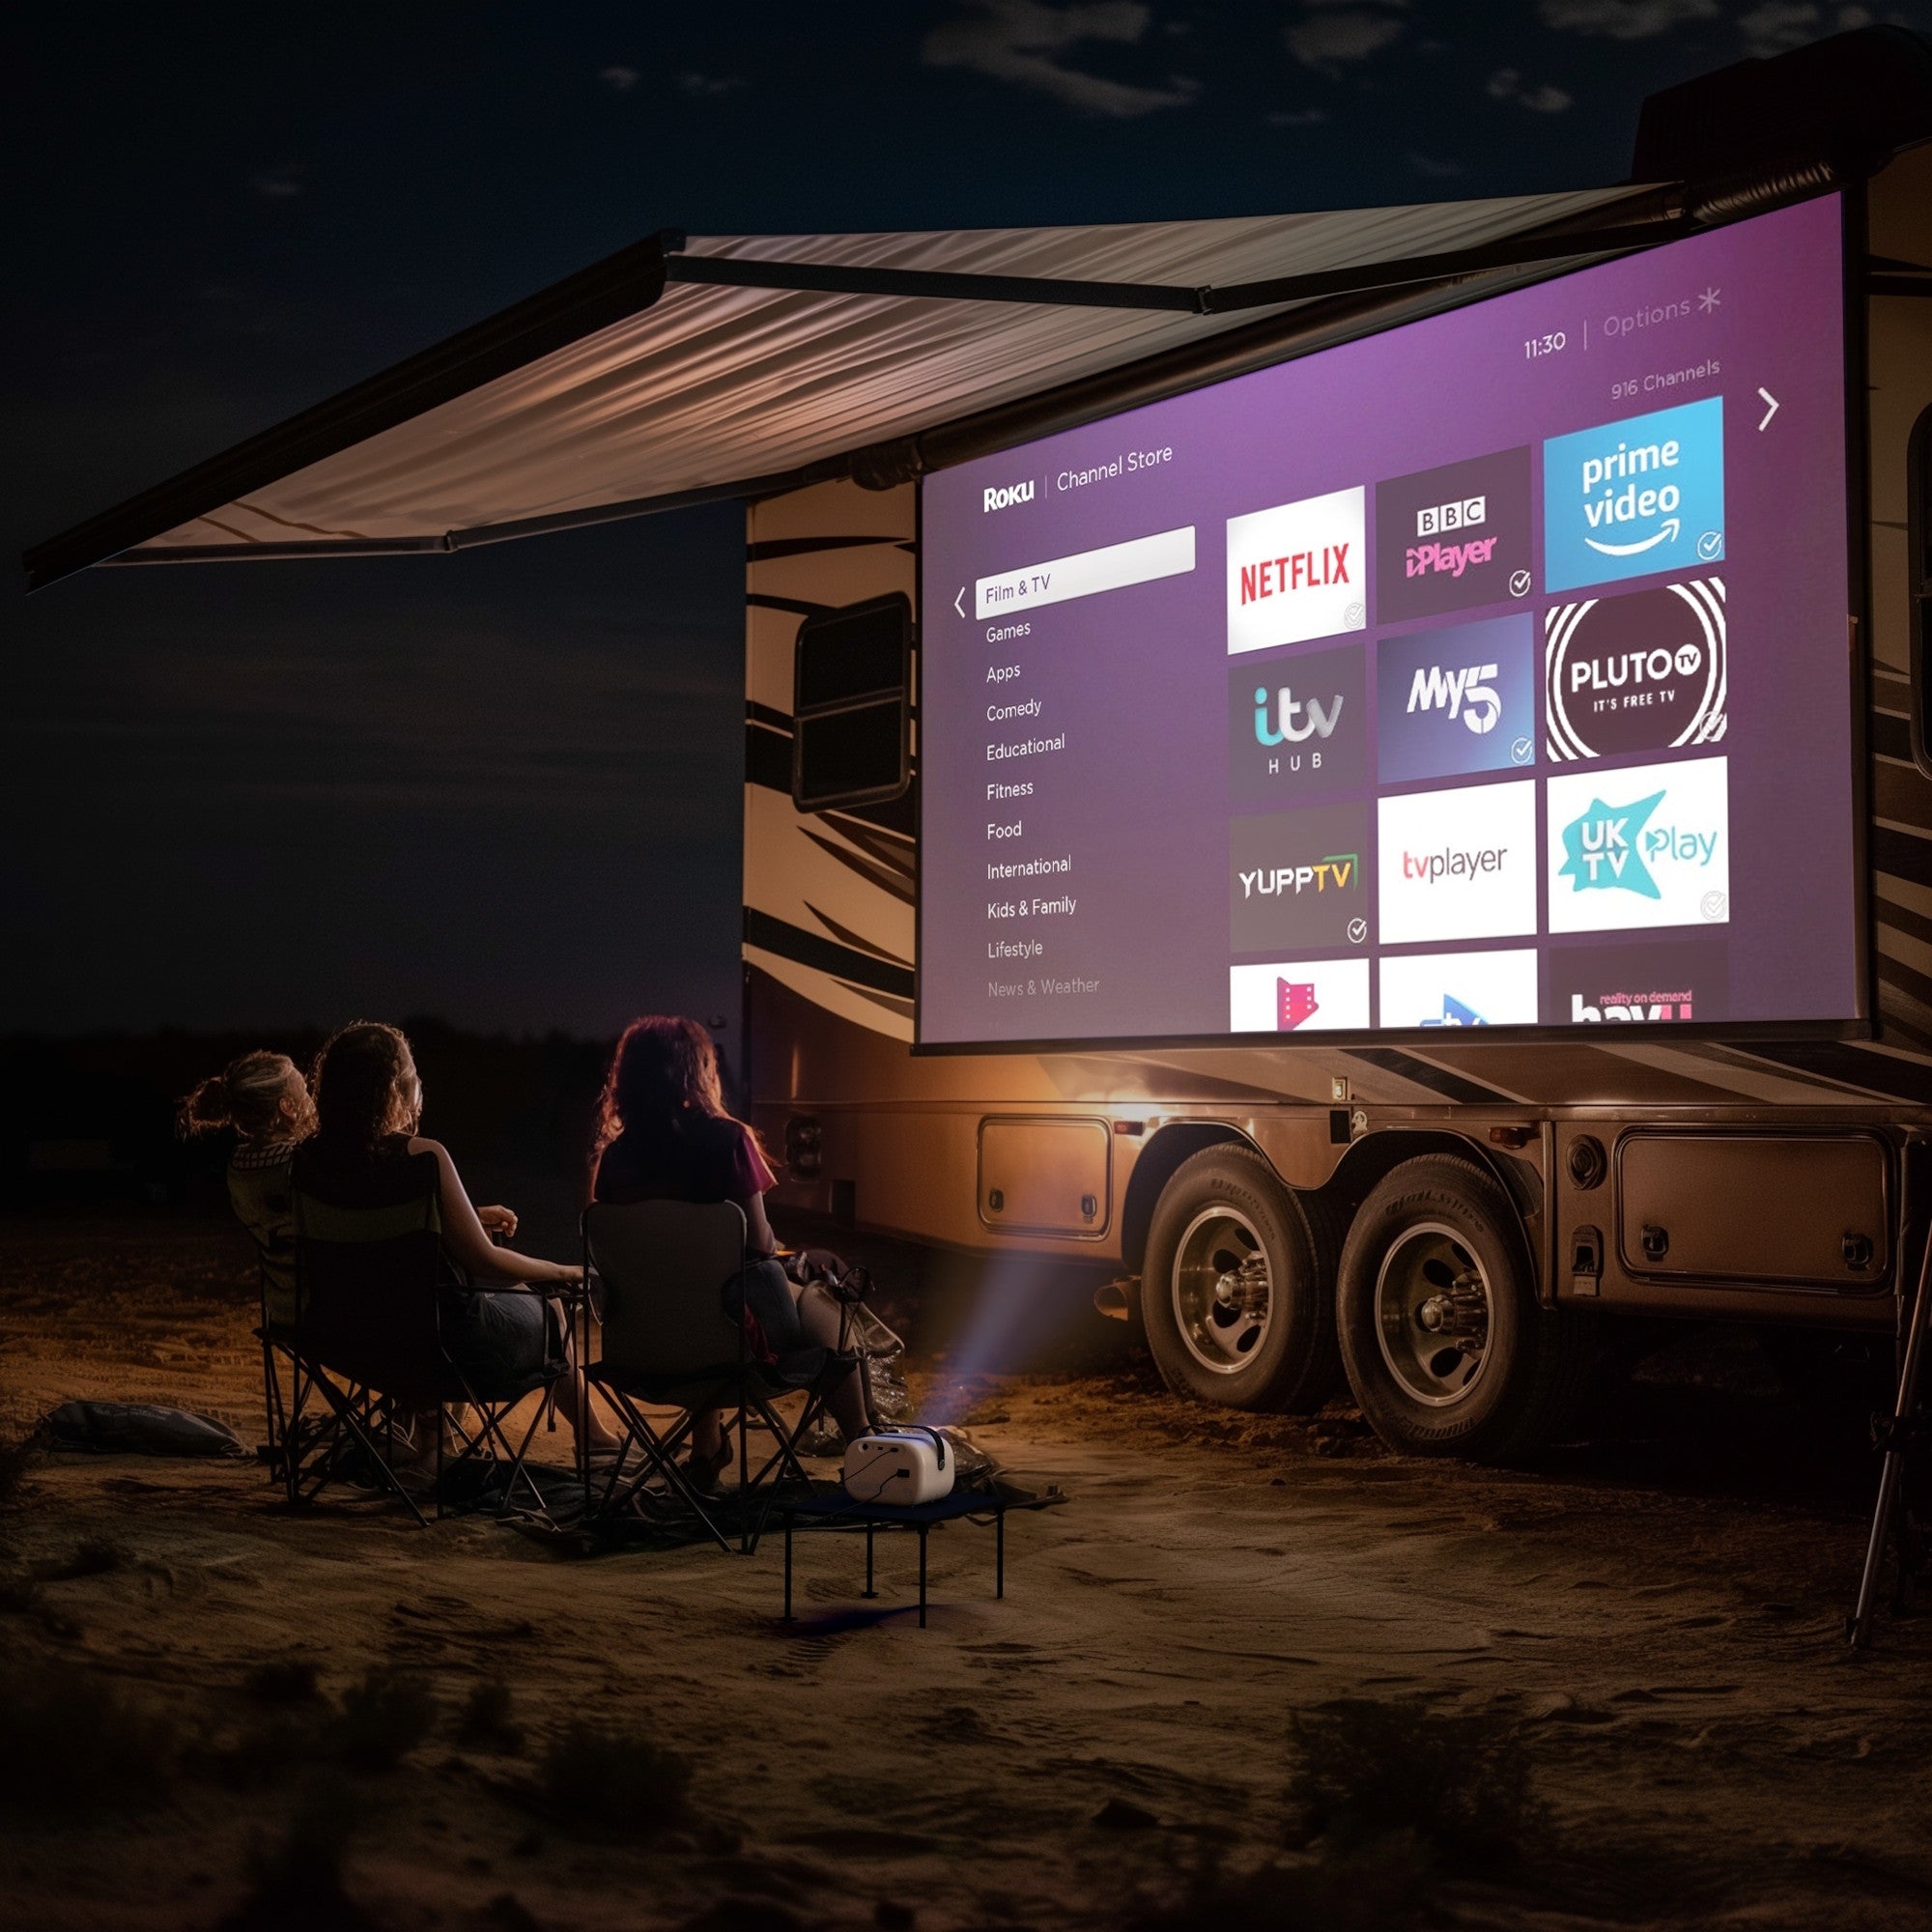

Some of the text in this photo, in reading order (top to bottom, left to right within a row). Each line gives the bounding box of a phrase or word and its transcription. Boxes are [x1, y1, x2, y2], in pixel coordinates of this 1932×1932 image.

[1604, 299, 1690, 336] Options
[1524, 331, 1566, 359] 11:30
[1611, 359, 1720, 400] 916 Channels
[1057, 455, 1122, 491] Channel
[1127, 446, 1173, 472] Store
[1582, 440, 1680, 494] prime
[1417, 496, 1486, 537] BBC
[1583, 483, 1681, 528] video
[1406, 536, 1498, 578] iPlayer
[985, 574, 1051, 604] Film & TV
[1241, 543, 1350, 606] NETFLIX
[986, 622, 1031, 643] Games
[986, 664, 1021, 683] Apps
[1571, 648, 1672, 693] PLUTO
[986, 698, 1041, 722] Comedy
[1406, 663, 1502, 735] My5
[1594, 690, 1675, 712] IT'S FREE TV
[1254, 687, 1344, 747] itv
[986, 732, 1065, 761] Educational
[1268, 753, 1322, 774] HUB
[986, 781, 1034, 800] Fitness
[987, 820, 1022, 839] Food
[1581, 816, 1630, 851] UK
[987, 854, 1071, 880] International
[1403, 847, 1508, 884] tvplayer
[1581, 849, 1630, 881] TV
[1238, 863, 1351, 899] YUPPTV
[987, 895, 1077, 919] Kids & Family
[987, 939, 1043, 959] Lifestyle
[988, 977, 1100, 997] News & Weather
[1600, 990, 1692, 1006] reality on demand
